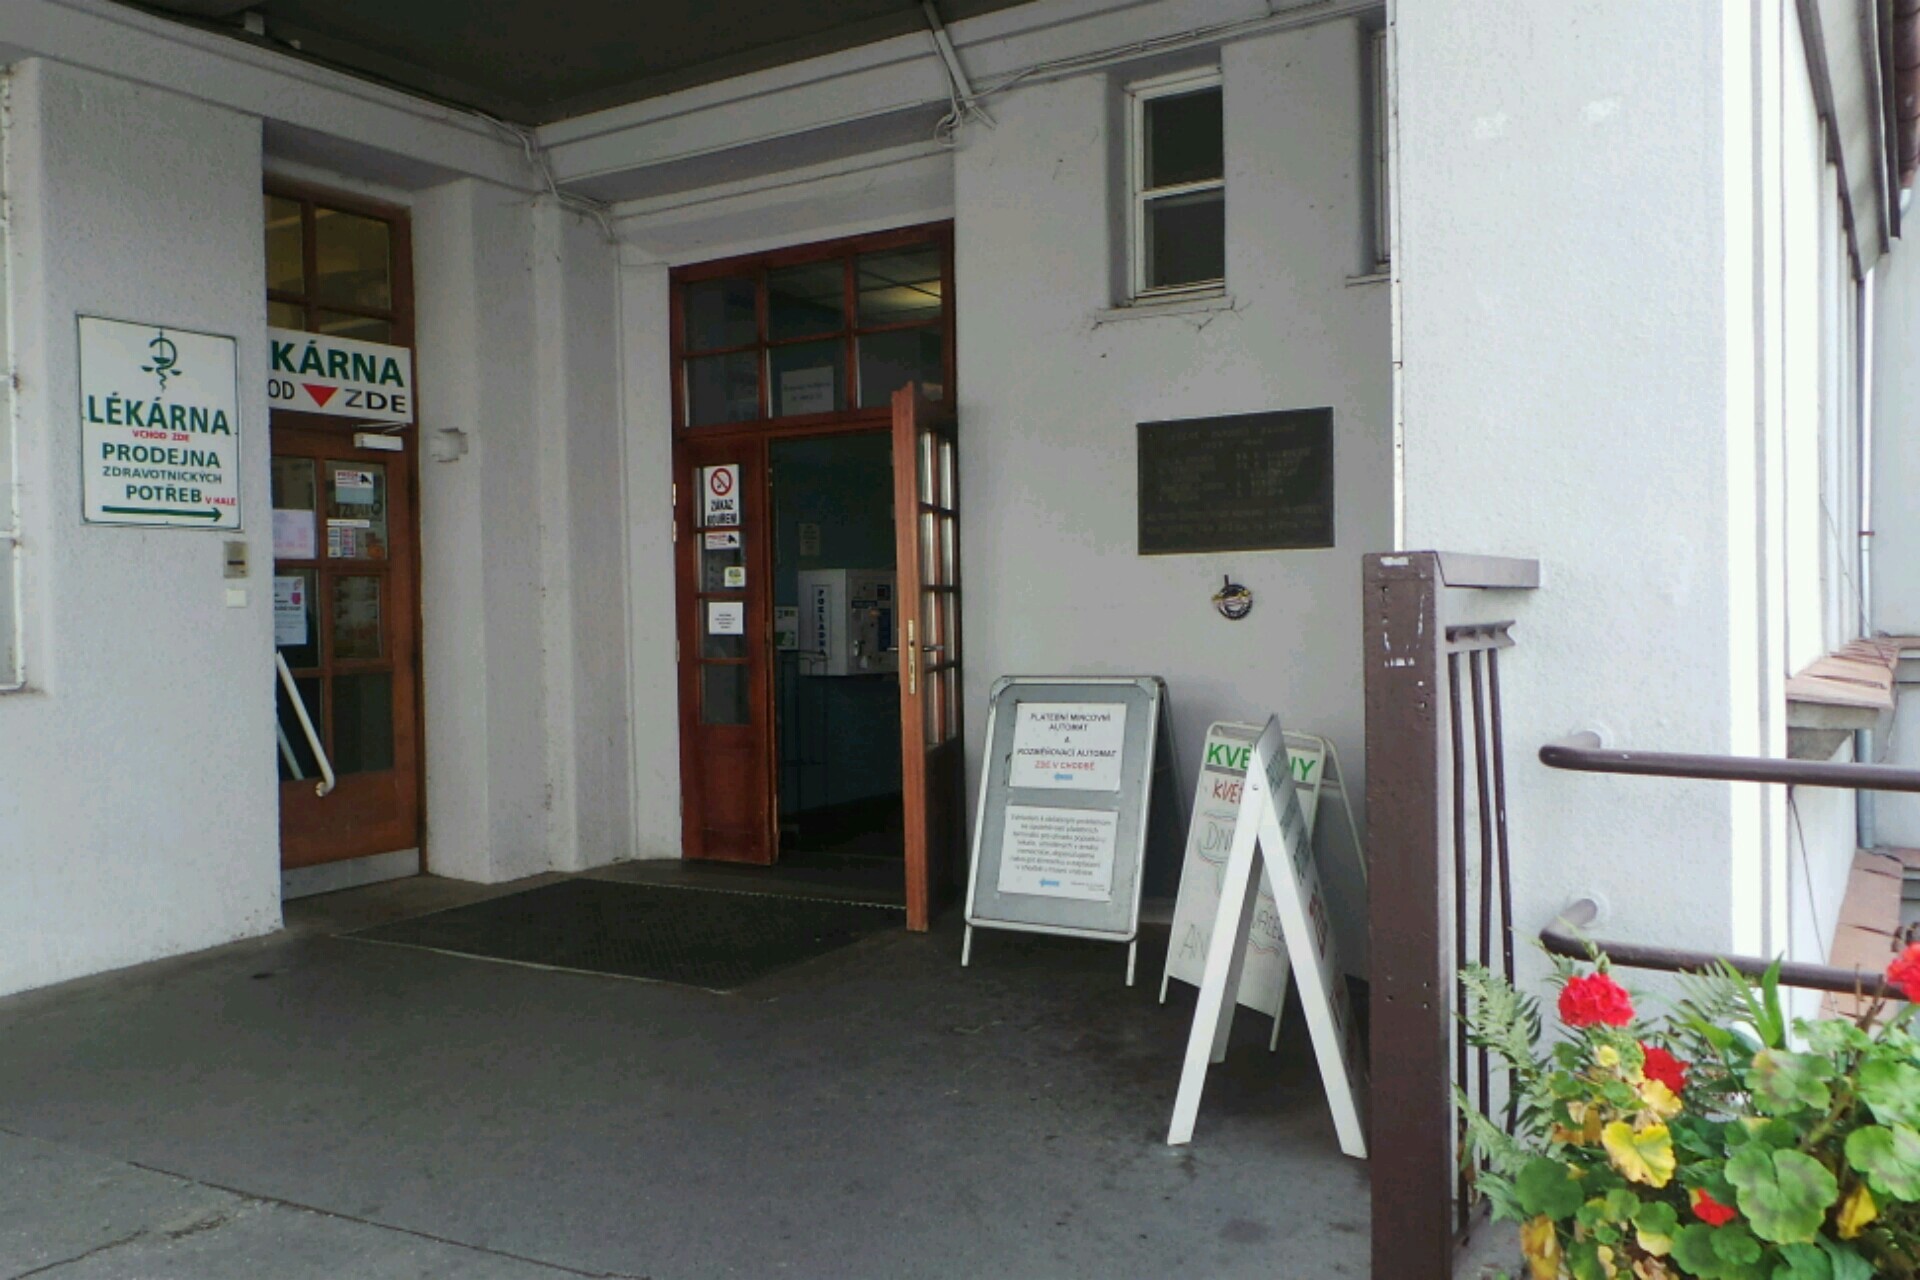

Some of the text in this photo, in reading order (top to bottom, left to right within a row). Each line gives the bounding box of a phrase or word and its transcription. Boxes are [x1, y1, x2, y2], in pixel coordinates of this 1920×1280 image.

[271, 338, 405, 388] KÁRNA
[344, 388, 407, 414] ZDE
[87, 391, 231, 436] LÉKÁRNA
[132, 429, 190, 442] VCHOD ZDE
[102, 442, 222, 468] PRODEJNA
[102, 465, 222, 484] ZDRAVOTNICKÝCH
[126, 483, 202, 503] POTŘEB
[205, 496, 236, 506] V HALE
[1049, 723, 1088, 732] AUTOMAT
[1076, 749, 1117, 758] AUTOMAT
